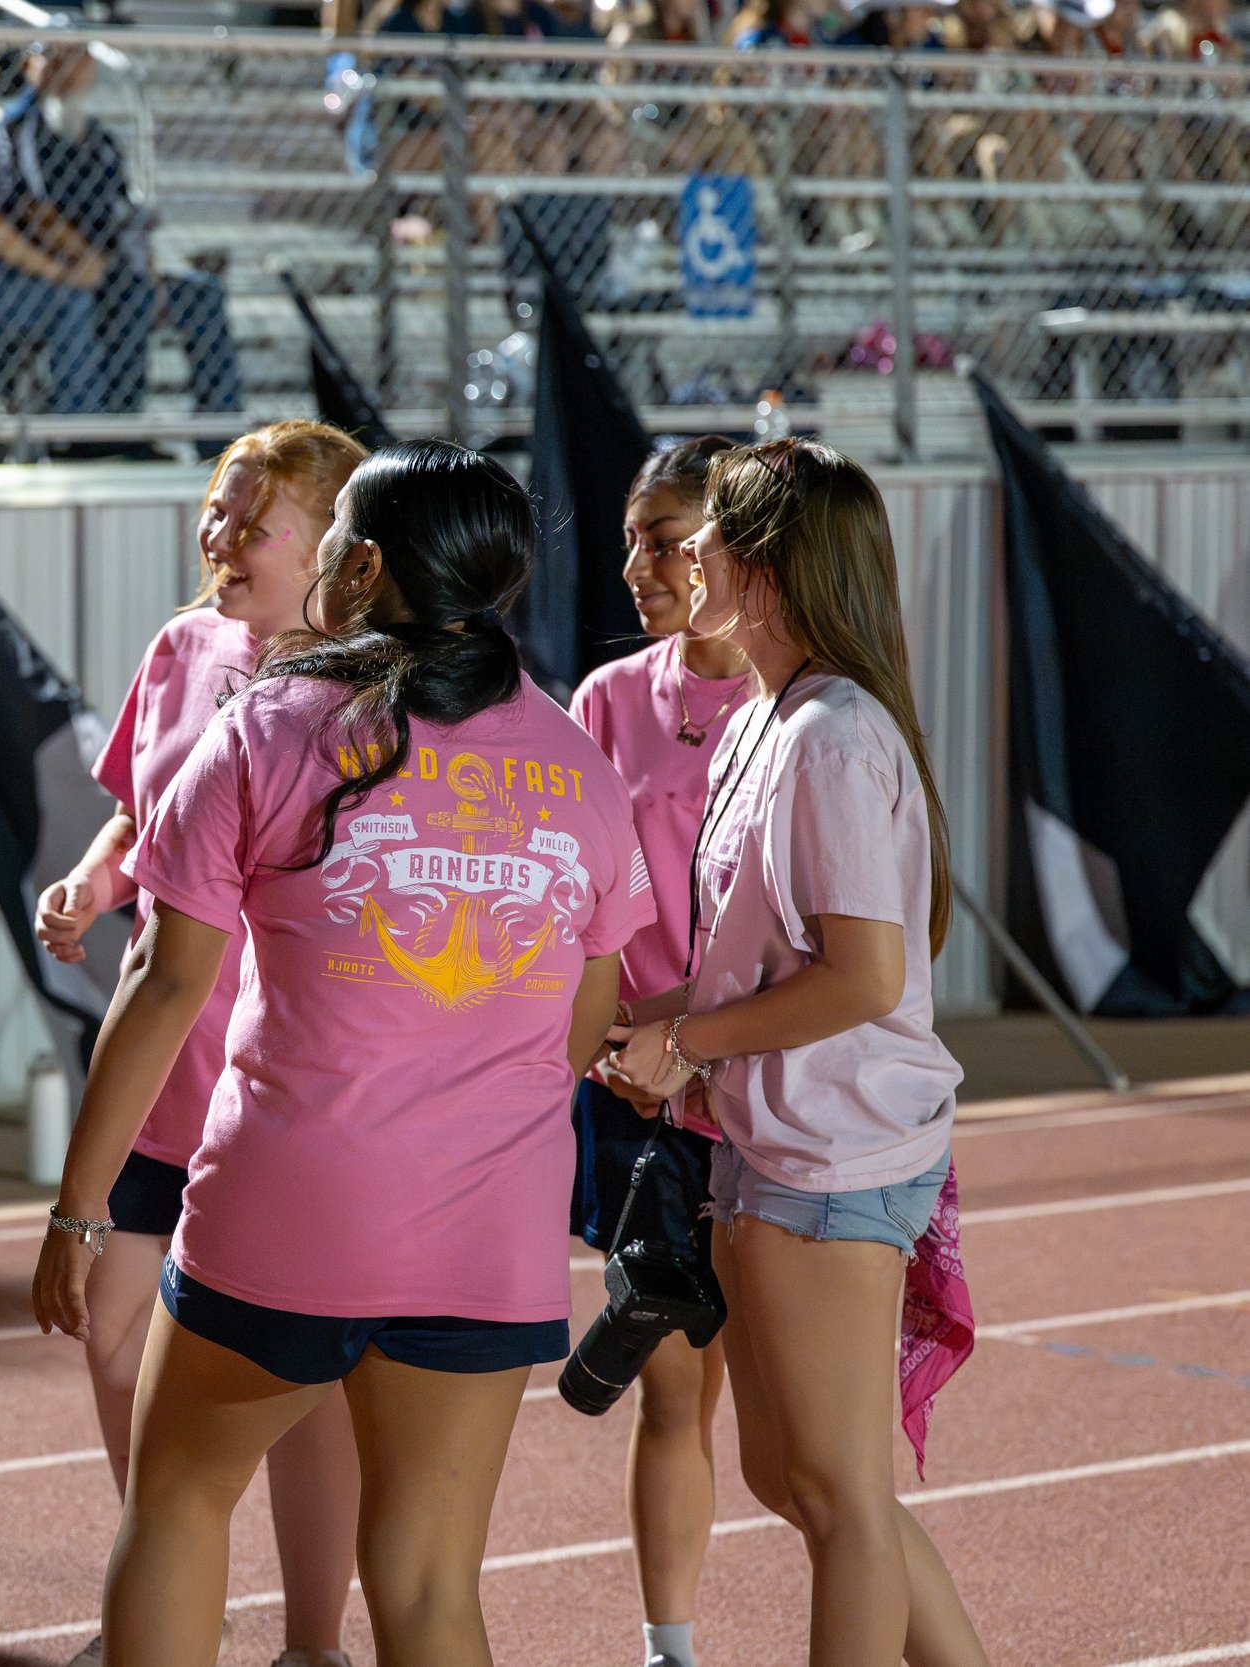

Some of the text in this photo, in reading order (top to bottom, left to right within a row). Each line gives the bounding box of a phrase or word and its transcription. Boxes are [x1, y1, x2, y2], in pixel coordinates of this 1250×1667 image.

[503, 757, 584, 801] FAST
[353, 821, 575, 853] SMITHSON VALLEY
[409, 854, 531, 888] RANGERS
[327, 959, 376, 976] NJROTC
